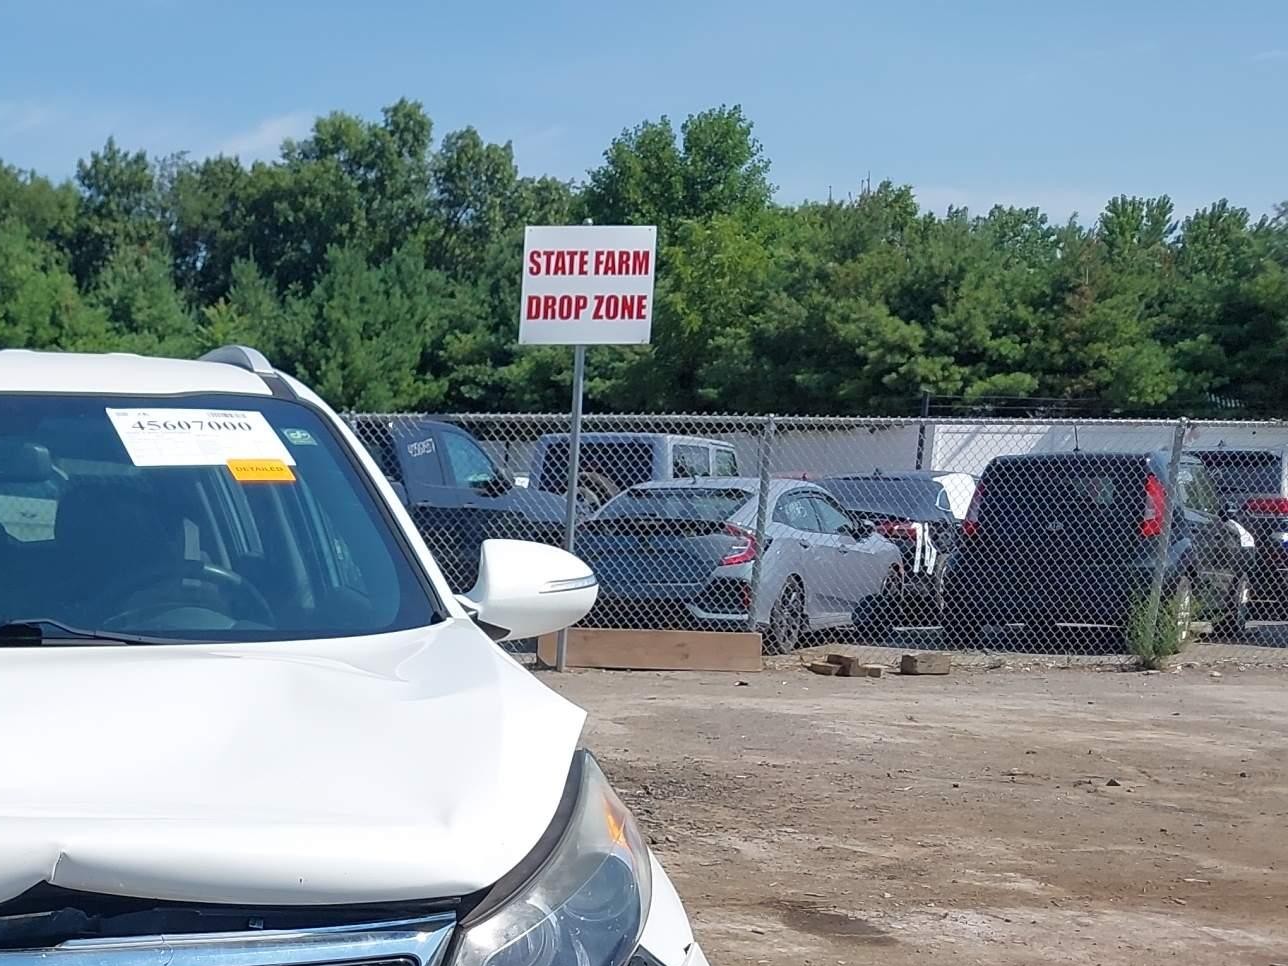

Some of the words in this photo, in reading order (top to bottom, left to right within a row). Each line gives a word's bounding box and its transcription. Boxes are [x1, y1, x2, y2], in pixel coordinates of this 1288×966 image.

[528, 250, 588, 276] STATE
[594, 250, 649, 276] FARM
[526, 295, 588, 321] DROP
[592, 295, 648, 320] ZONE
[131, 420, 252, 432] 45607000
[235, 465, 284, 473] DETAILED
